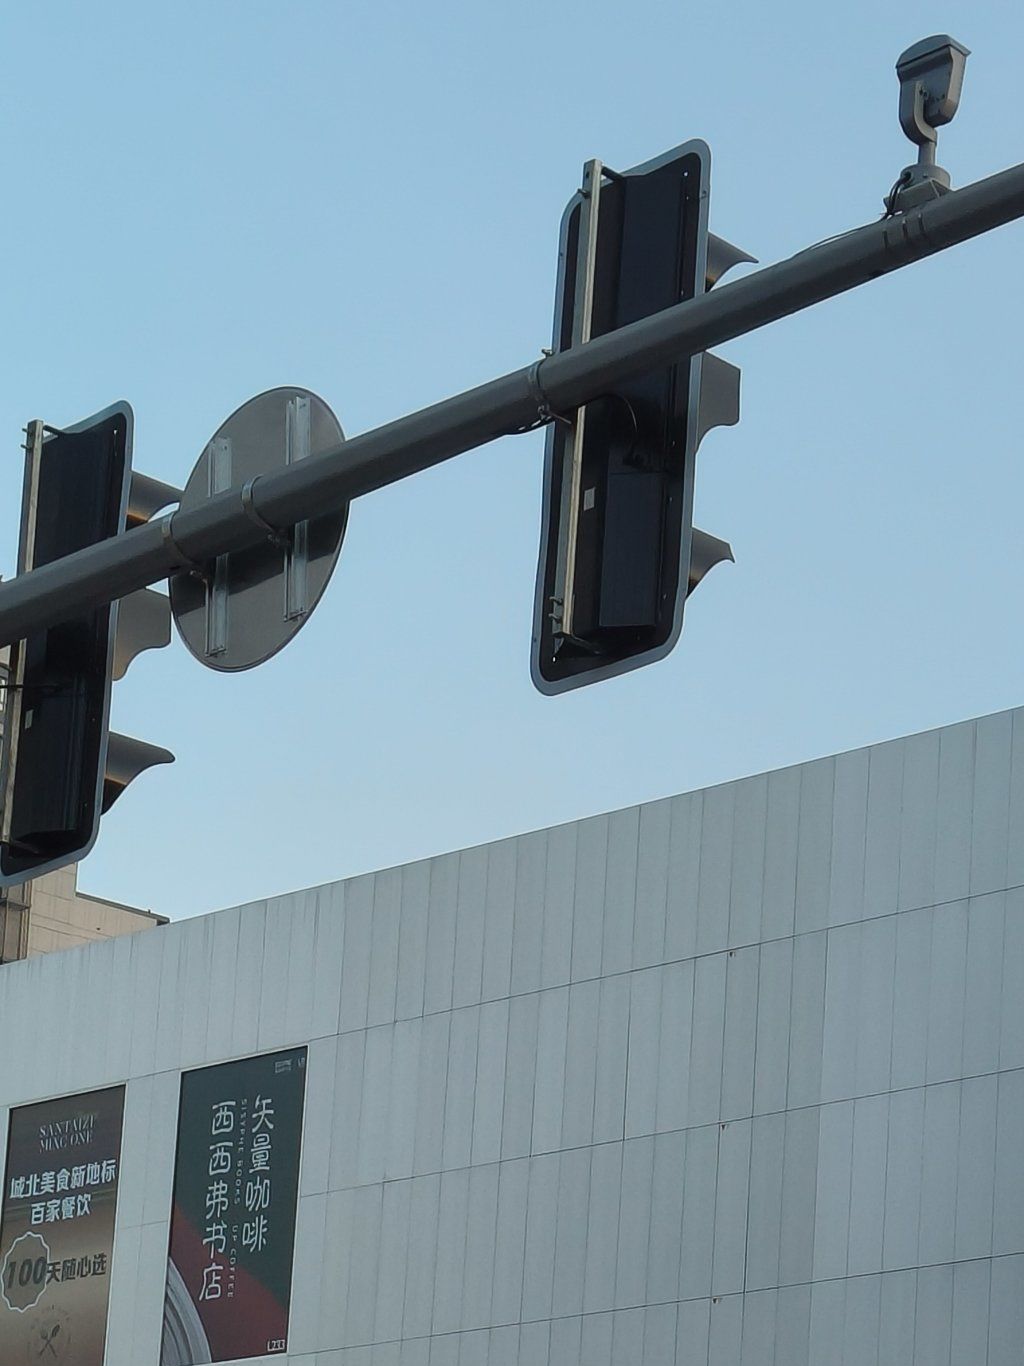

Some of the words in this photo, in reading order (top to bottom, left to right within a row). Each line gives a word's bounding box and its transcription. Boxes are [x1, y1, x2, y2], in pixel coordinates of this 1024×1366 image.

[9, 1159, 117, 1199] 城北美食新地标
[242, 1094, 275, 1253] 矢量咖啡
[31, 1193, 92, 1225] 百家餐饮
[199, 1100, 236, 1301] 西西弗书店
[7, 1252, 108, 1289] 100天随心选
